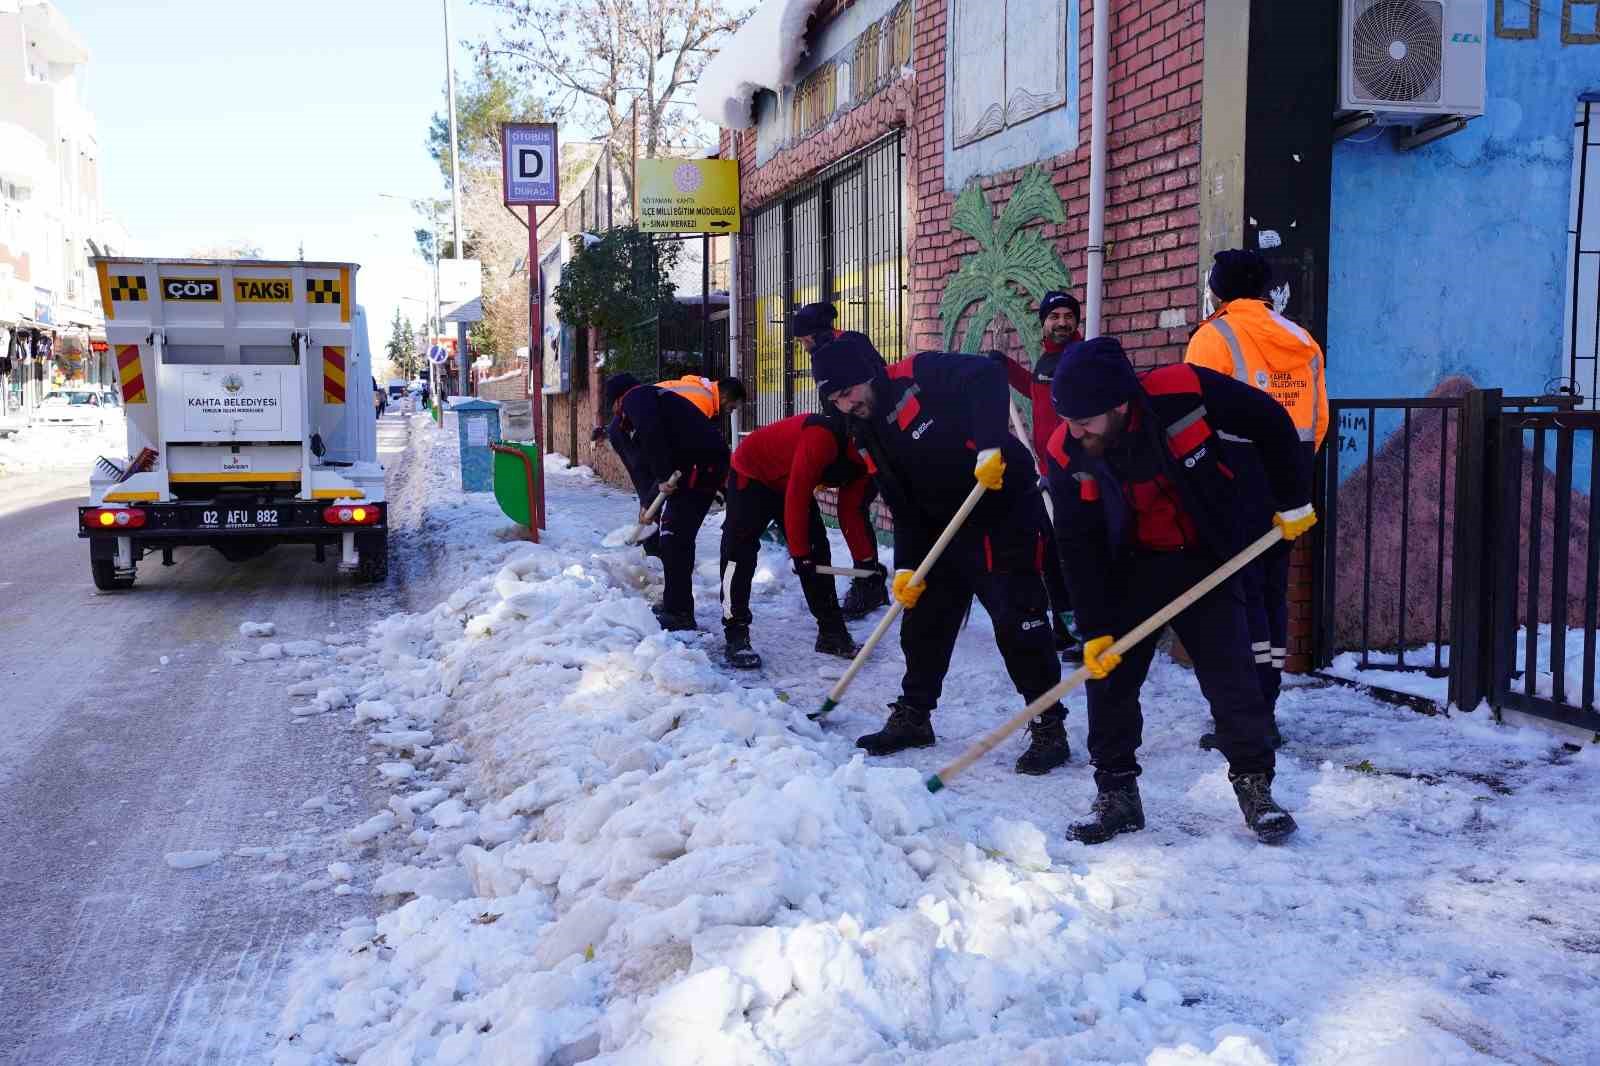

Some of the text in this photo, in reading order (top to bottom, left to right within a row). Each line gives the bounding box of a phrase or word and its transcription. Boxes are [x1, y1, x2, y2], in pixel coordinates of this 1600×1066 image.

[520, 149, 543, 178] D
[168, 280, 214, 299] ÇÖP
[188, 398, 221, 407] KAHTA
[203, 510, 278, 524] 02 AFU 882
